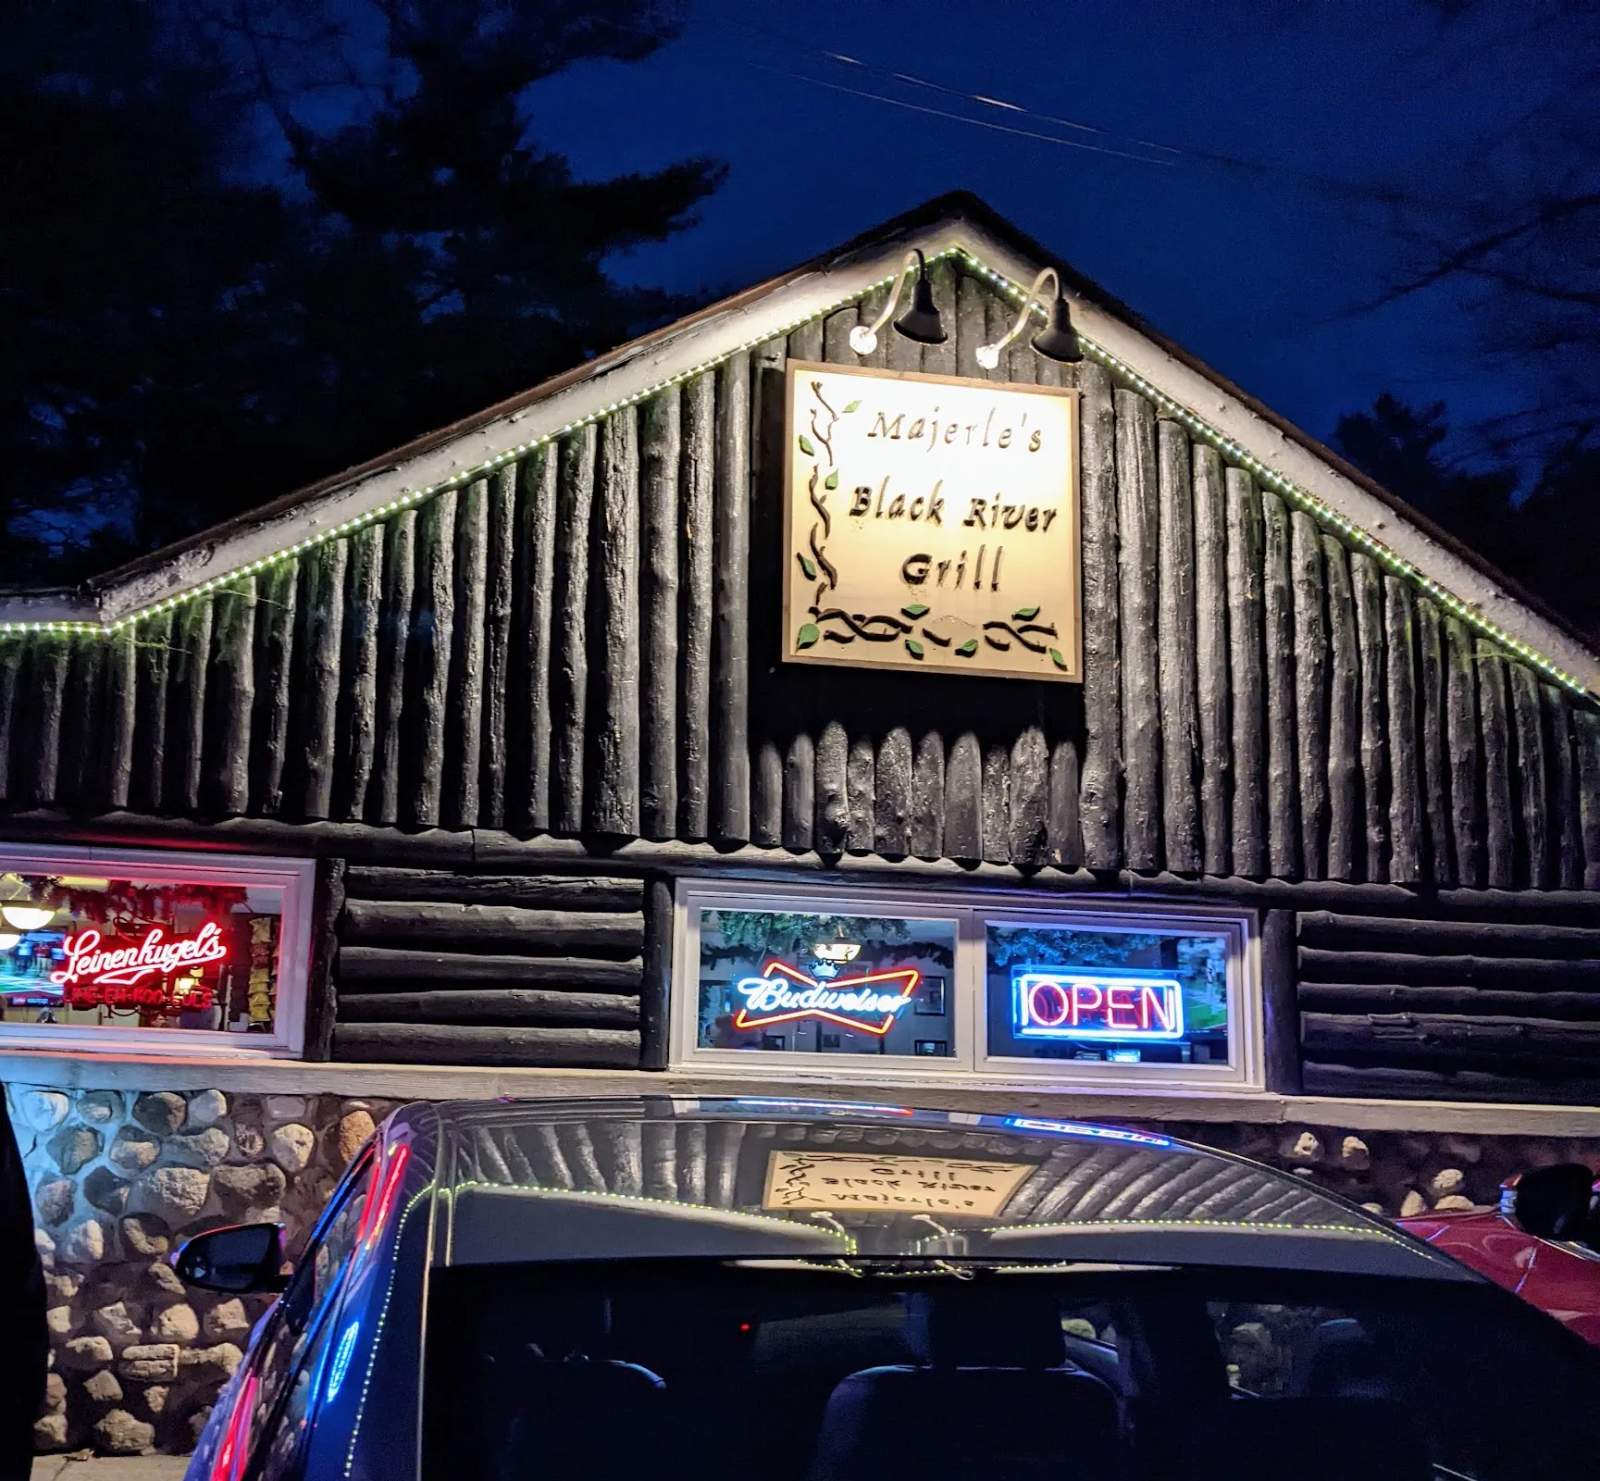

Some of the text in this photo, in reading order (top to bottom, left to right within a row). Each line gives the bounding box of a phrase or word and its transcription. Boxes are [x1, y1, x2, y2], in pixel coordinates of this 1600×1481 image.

[866, 405, 1042, 452] Majerle's
[848, 475, 1057, 533] Black River
[901, 543, 1004, 592] Grill
[50, 921, 227, 985] Leinenkugel's
[737, 977, 912, 1014] Budweiser
[1028, 981, 1175, 1032] OPEN
